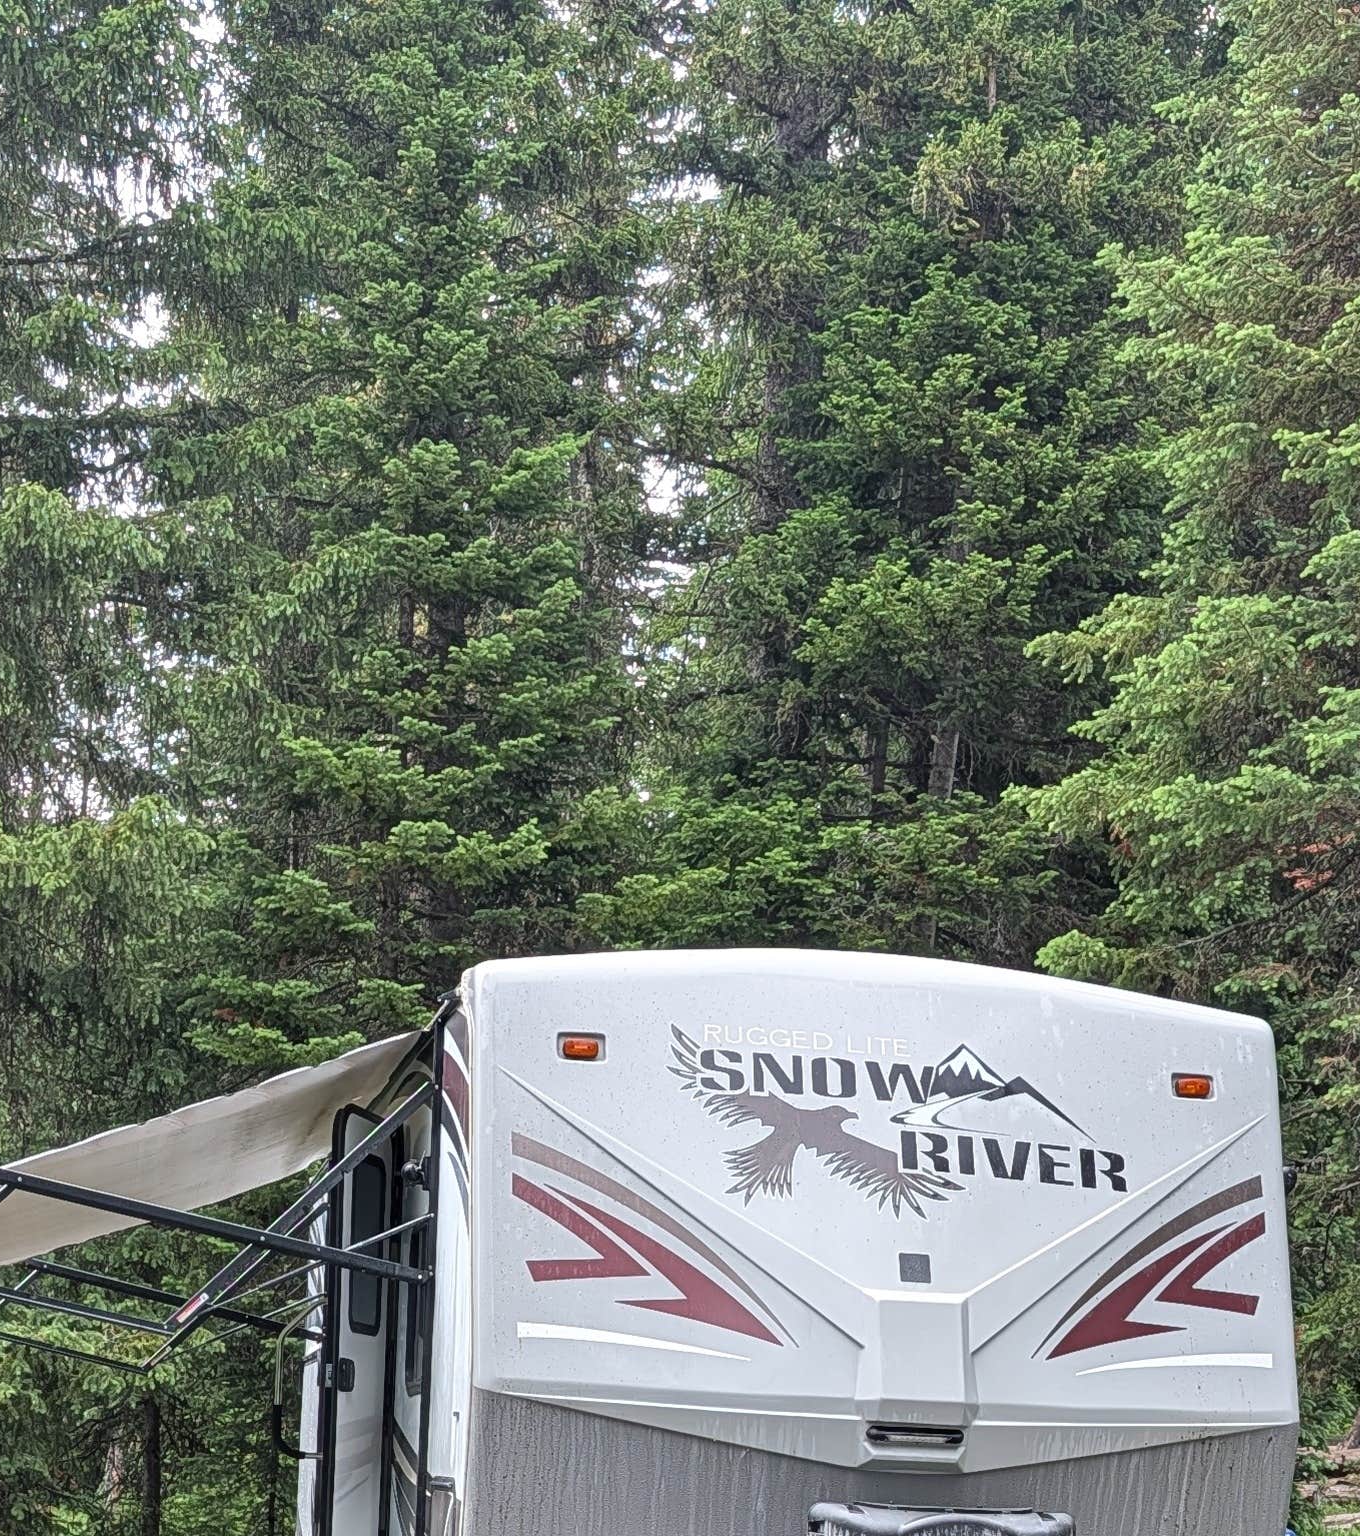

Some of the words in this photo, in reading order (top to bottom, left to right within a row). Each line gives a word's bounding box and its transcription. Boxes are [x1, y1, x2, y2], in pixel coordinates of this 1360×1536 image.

[703, 1022, 834, 1051] RUGGED
[847, 1033, 912, 1058] LITE
[699, 1048, 936, 1105] SNOW
[900, 1129, 1129, 1193] RIVER
